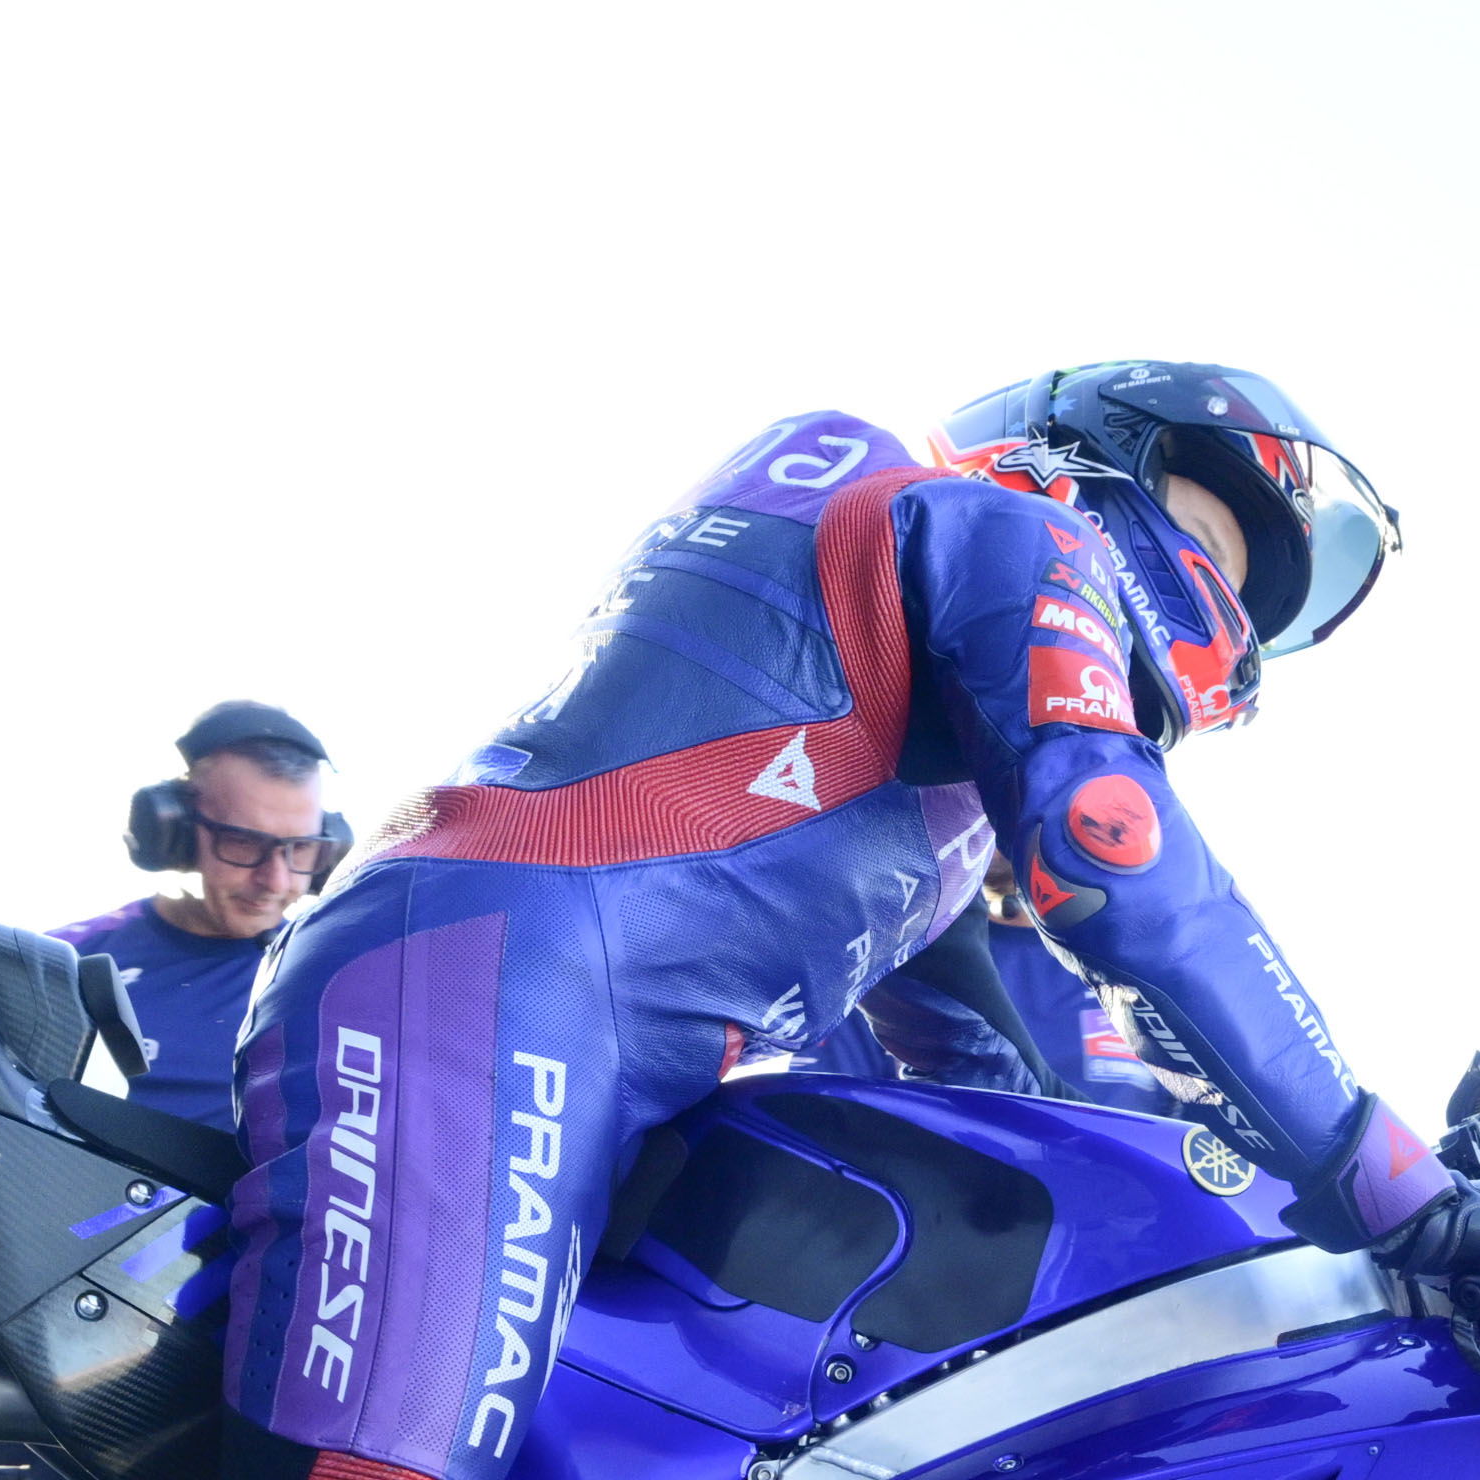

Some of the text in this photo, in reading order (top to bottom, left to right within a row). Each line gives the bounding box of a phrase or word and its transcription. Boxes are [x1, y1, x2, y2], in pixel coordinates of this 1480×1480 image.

[1039, 603, 1128, 677] MOT
[1101, 532, 1171, 647] PRAMAC
[1046, 696, 1138, 723] PRAM
[1179, 674, 1202, 731] PRAM
[1130, 987, 1275, 1151] DAINSE
[1247, 932, 1360, 1101] PRAMAC
[302, 1026, 382, 1403] DAINESE
[467, 1050, 567, 1458] PRAMAC
